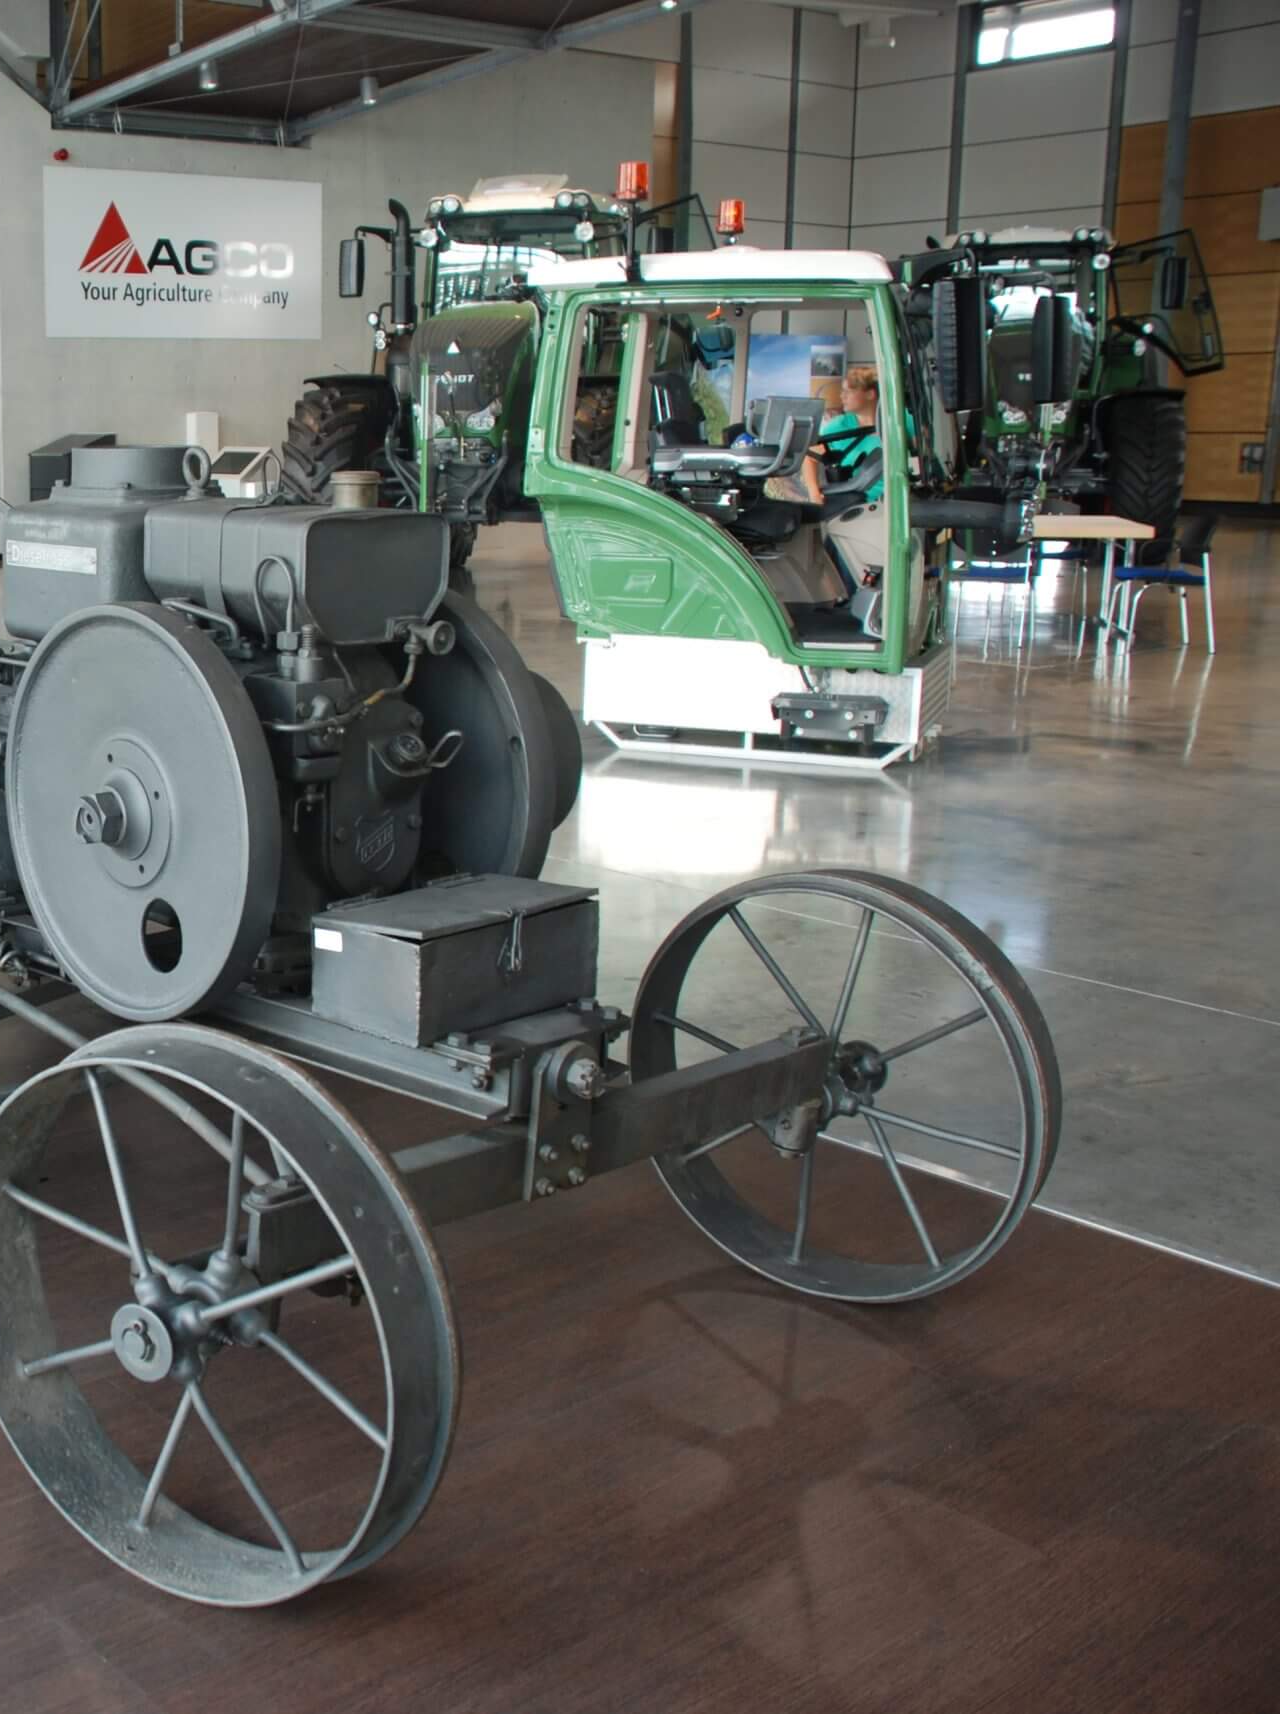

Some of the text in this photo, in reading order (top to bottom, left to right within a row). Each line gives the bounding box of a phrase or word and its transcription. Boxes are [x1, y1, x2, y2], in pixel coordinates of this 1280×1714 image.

[147, 238, 294, 280] AGCO
[81, 281, 118, 302] Your
[123, 282, 213, 307] Agriculture
